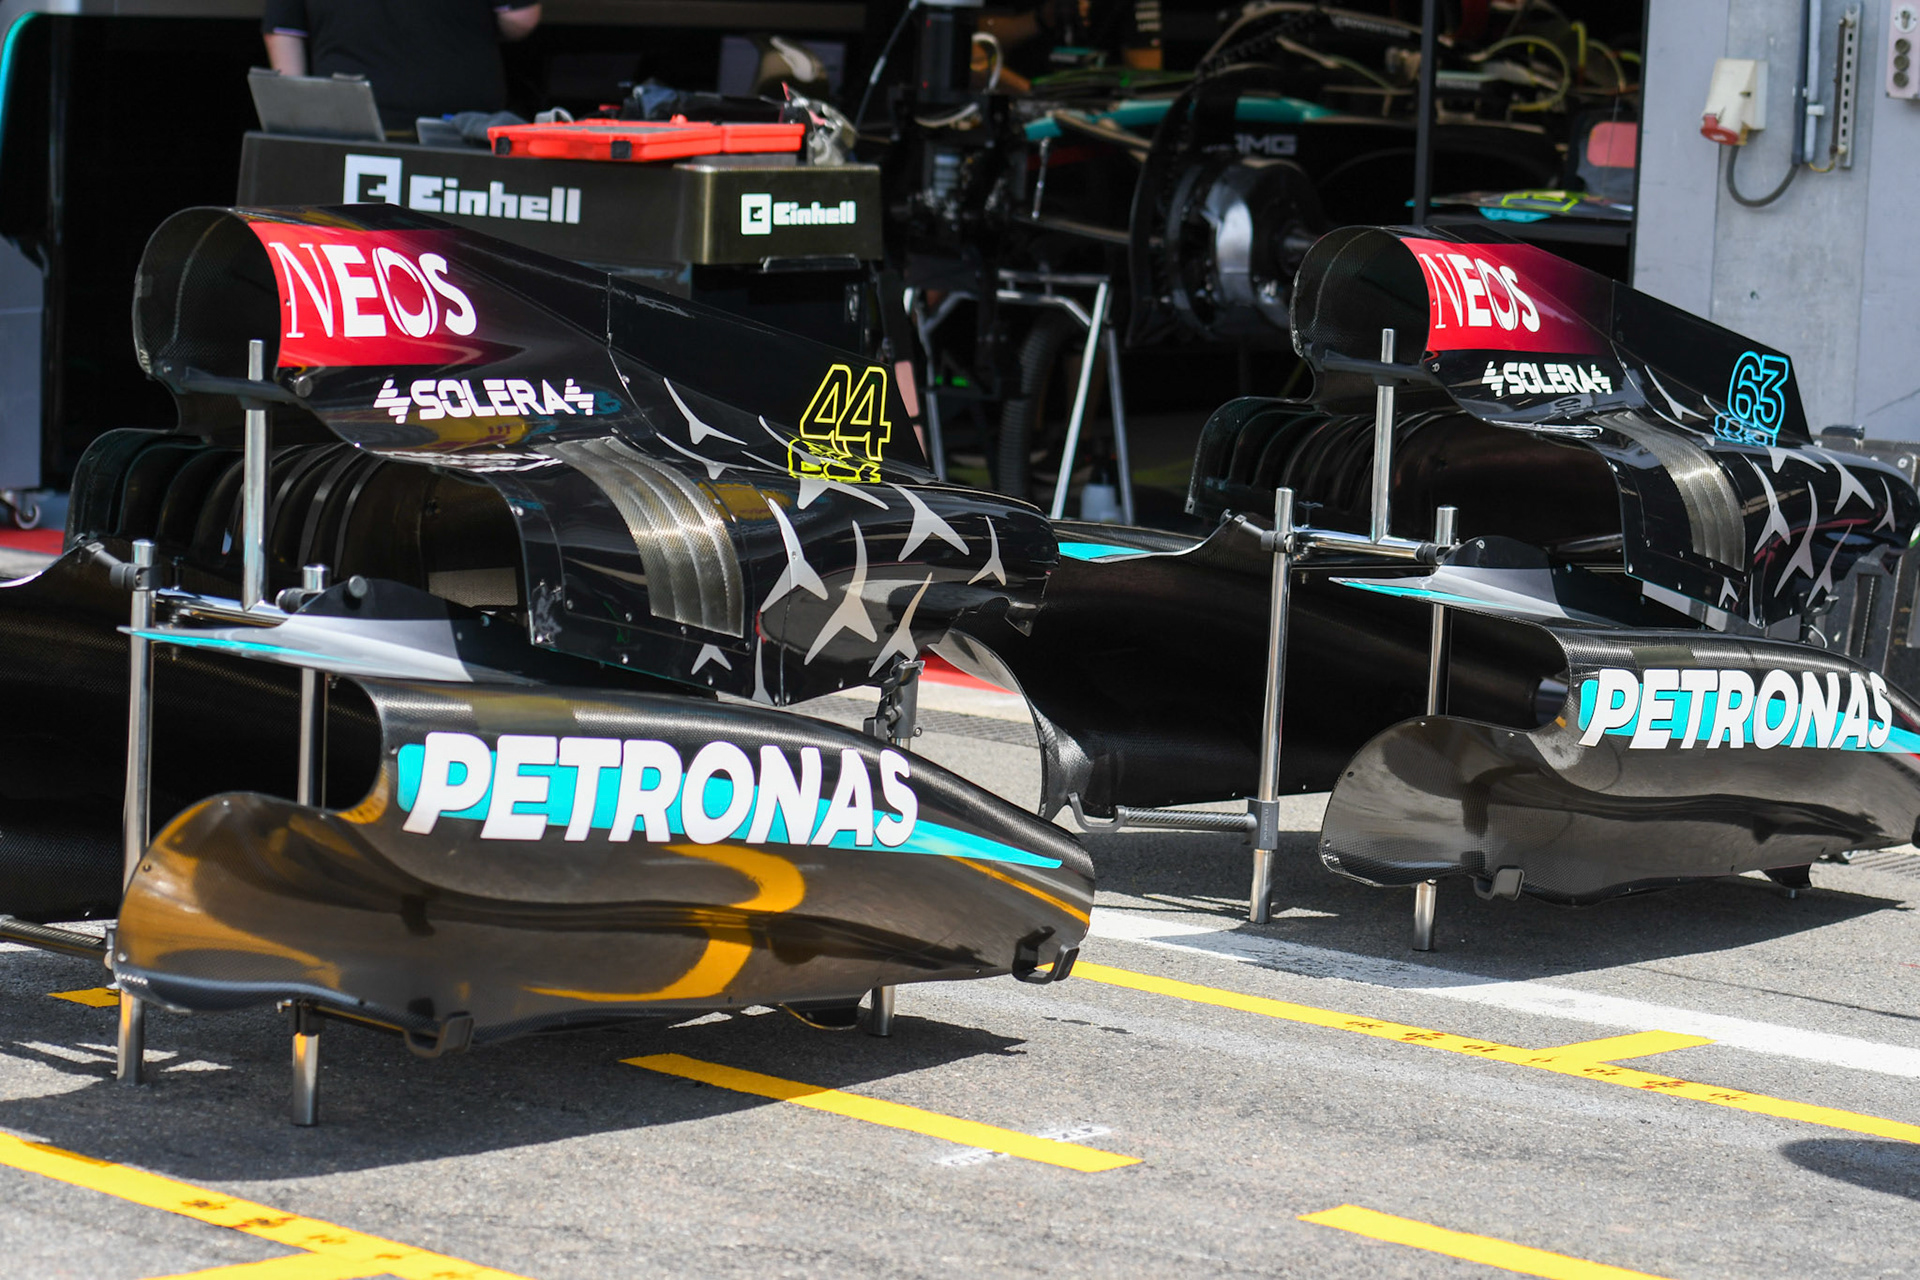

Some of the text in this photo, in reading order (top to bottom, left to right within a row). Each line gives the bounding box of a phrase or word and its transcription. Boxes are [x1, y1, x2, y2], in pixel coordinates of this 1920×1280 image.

[409, 176, 581, 224] Einhell
[773, 201, 856, 227] Einhell
[268, 242, 477, 338] NEOS
[1418, 253, 1541, 332] NEOS
[410, 379, 577, 420] SOLERA
[800, 364, 892, 461] 44
[1502, 362, 1603, 395] SOLERA
[1727, 350, 1790, 434] 63
[1578, 668, 1893, 750] PETRONAS
[403, 732, 918, 847] PETRONAS
